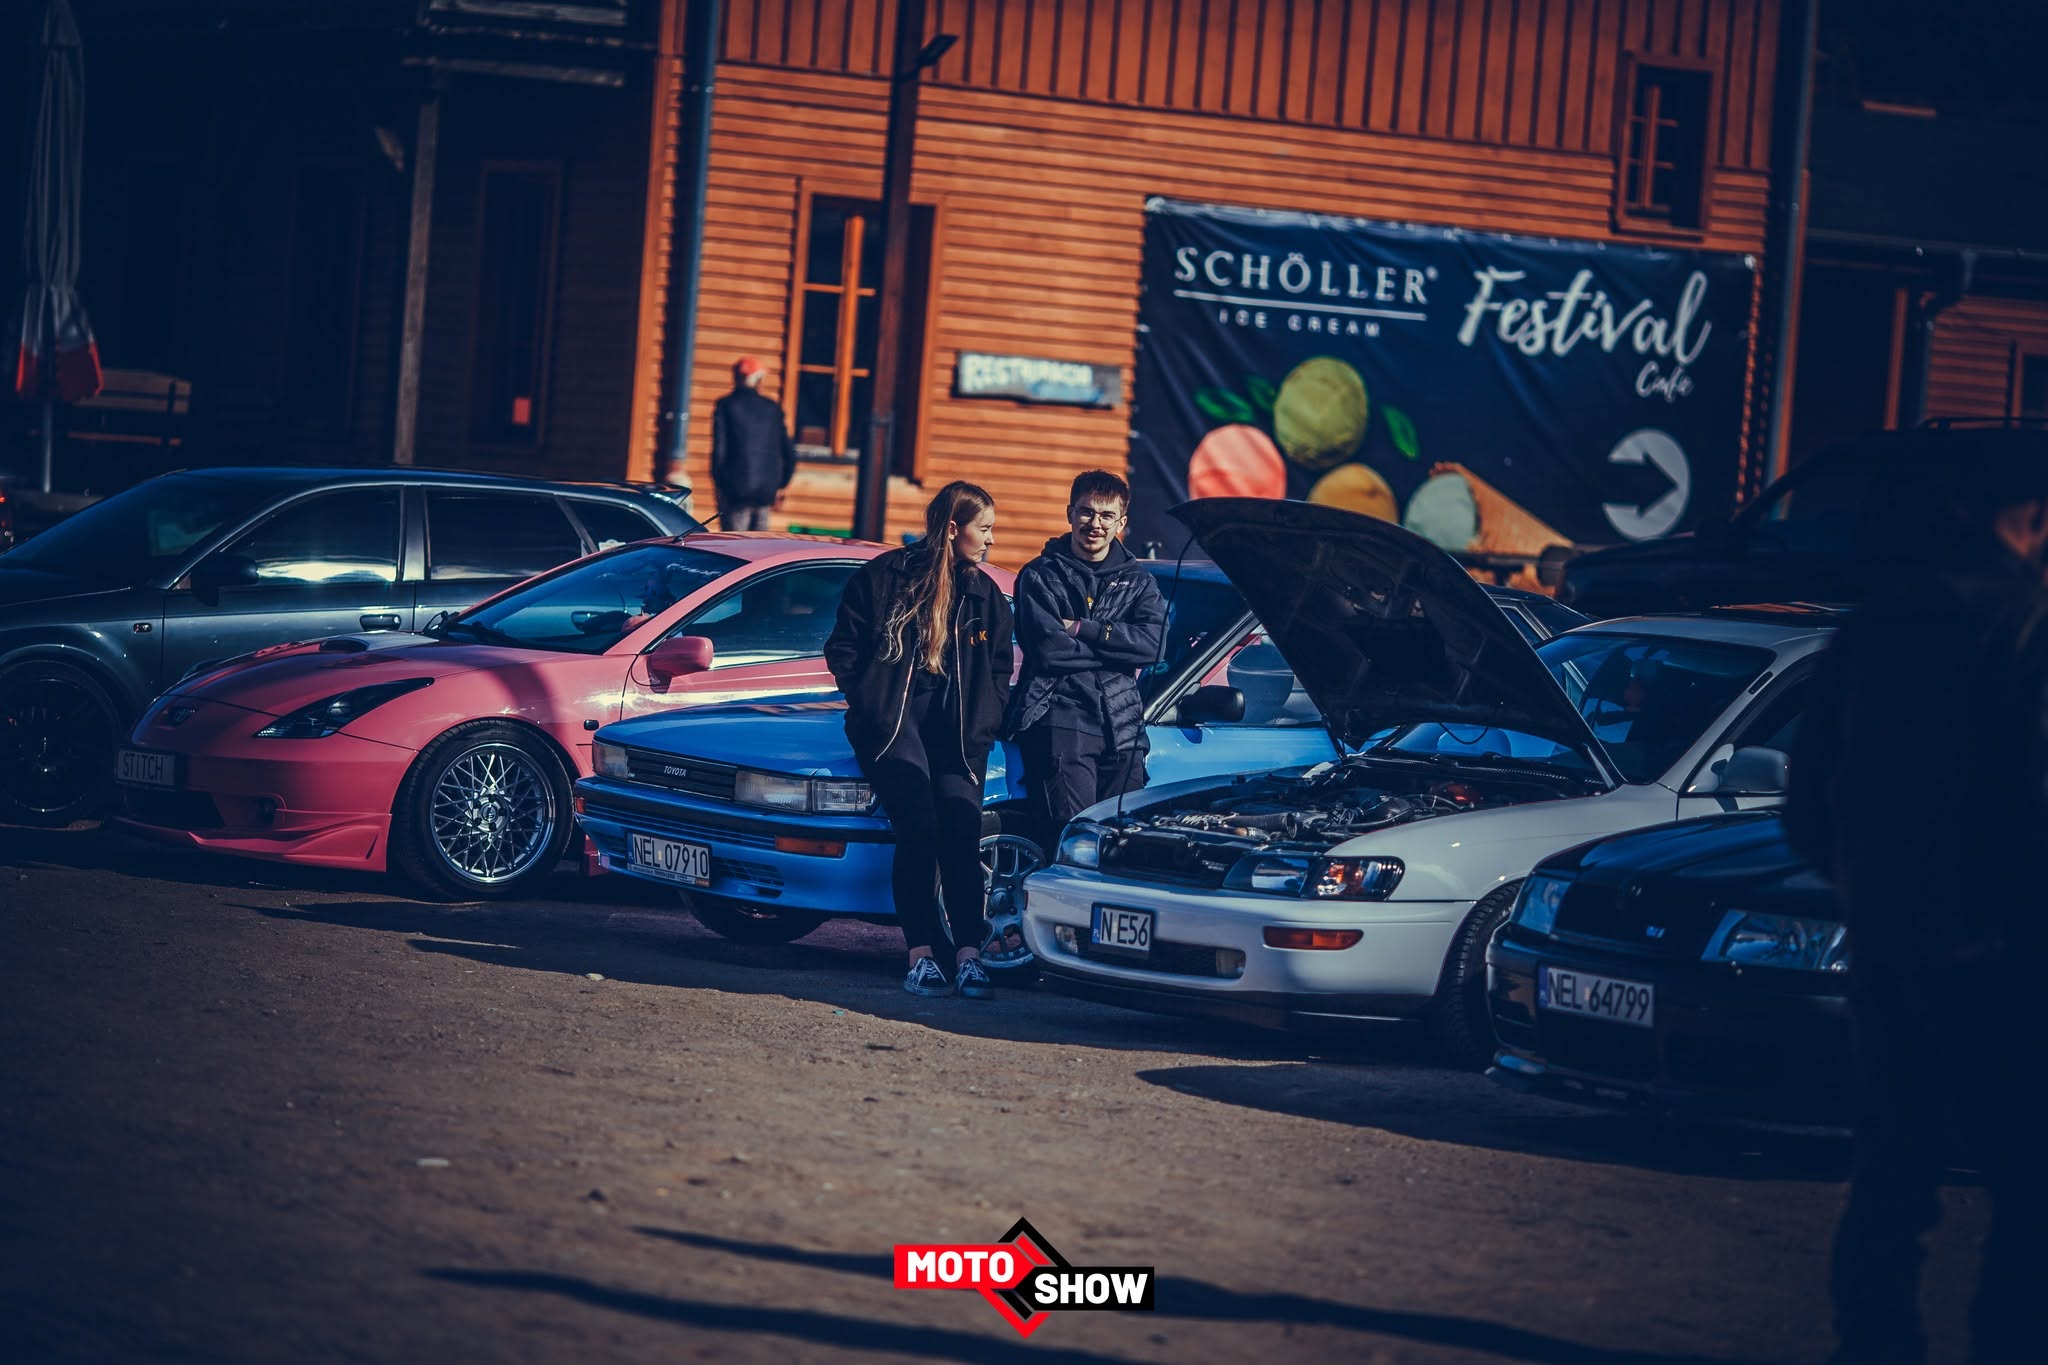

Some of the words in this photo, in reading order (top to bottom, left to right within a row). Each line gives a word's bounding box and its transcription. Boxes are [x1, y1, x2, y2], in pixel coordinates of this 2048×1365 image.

[1218, 307, 1267, 329] ICE
[1287, 313, 1380, 338] CREAM
[1457, 265, 1713, 366] Festival
[123, 751, 164, 781] STITCH
[664, 765, 687, 777] TOYOTA
[634, 836, 660, 868] NEL
[665, 843, 708, 877] 07910
[1548, 971, 1582, 1010] NEL
[1589, 979, 1650, 1021] 64799
